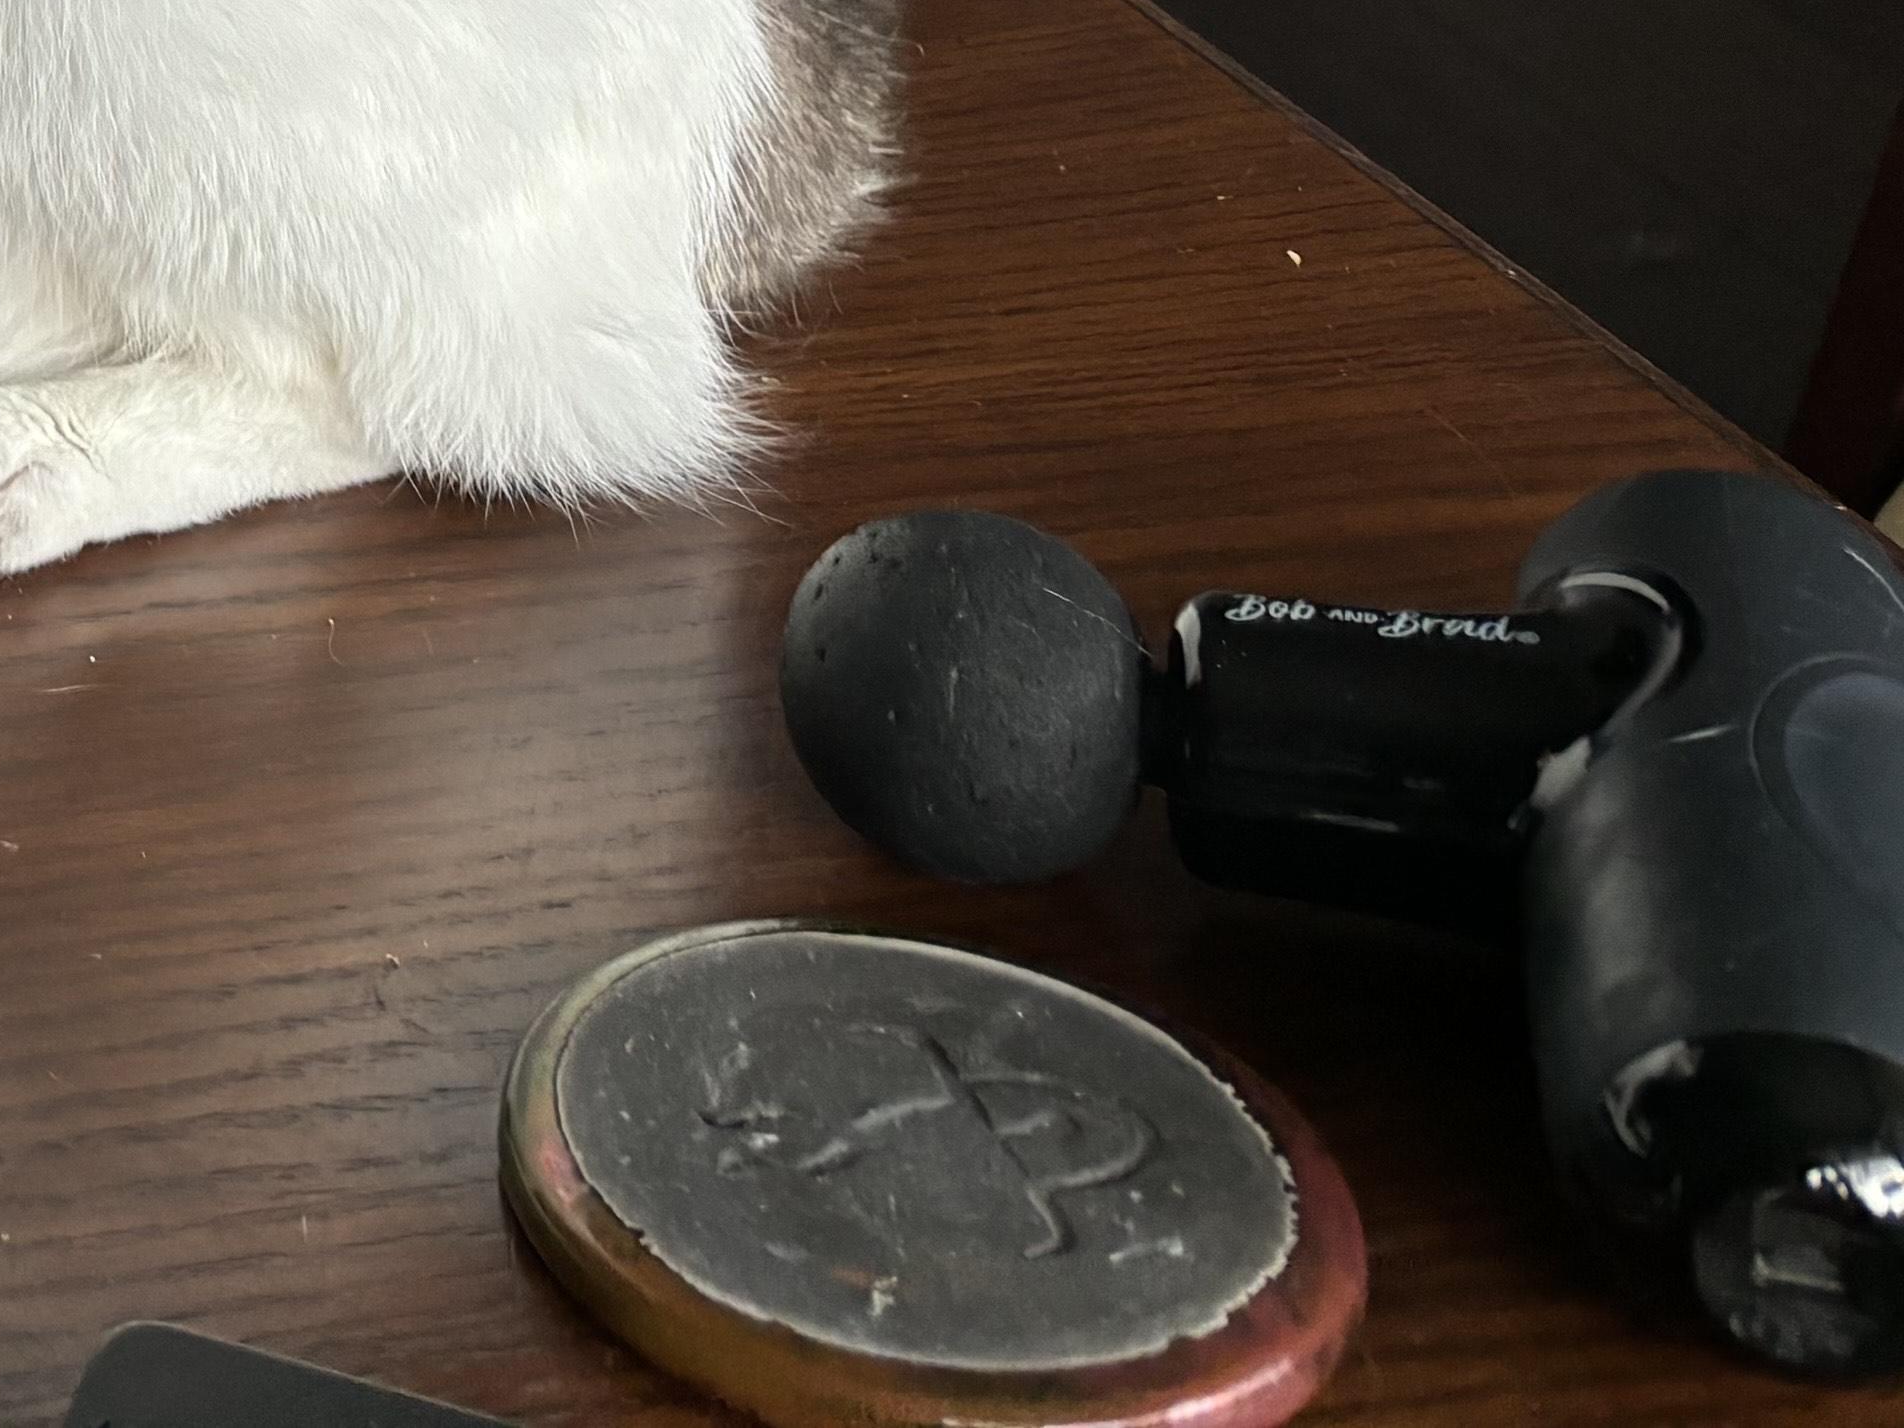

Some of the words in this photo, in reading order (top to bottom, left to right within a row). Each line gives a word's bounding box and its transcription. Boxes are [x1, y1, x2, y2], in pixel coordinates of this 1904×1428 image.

[1224, 594, 1315, 622] Bob
[1327, 607, 1378, 625] AND
[1377, 610, 1510, 641] Brad
